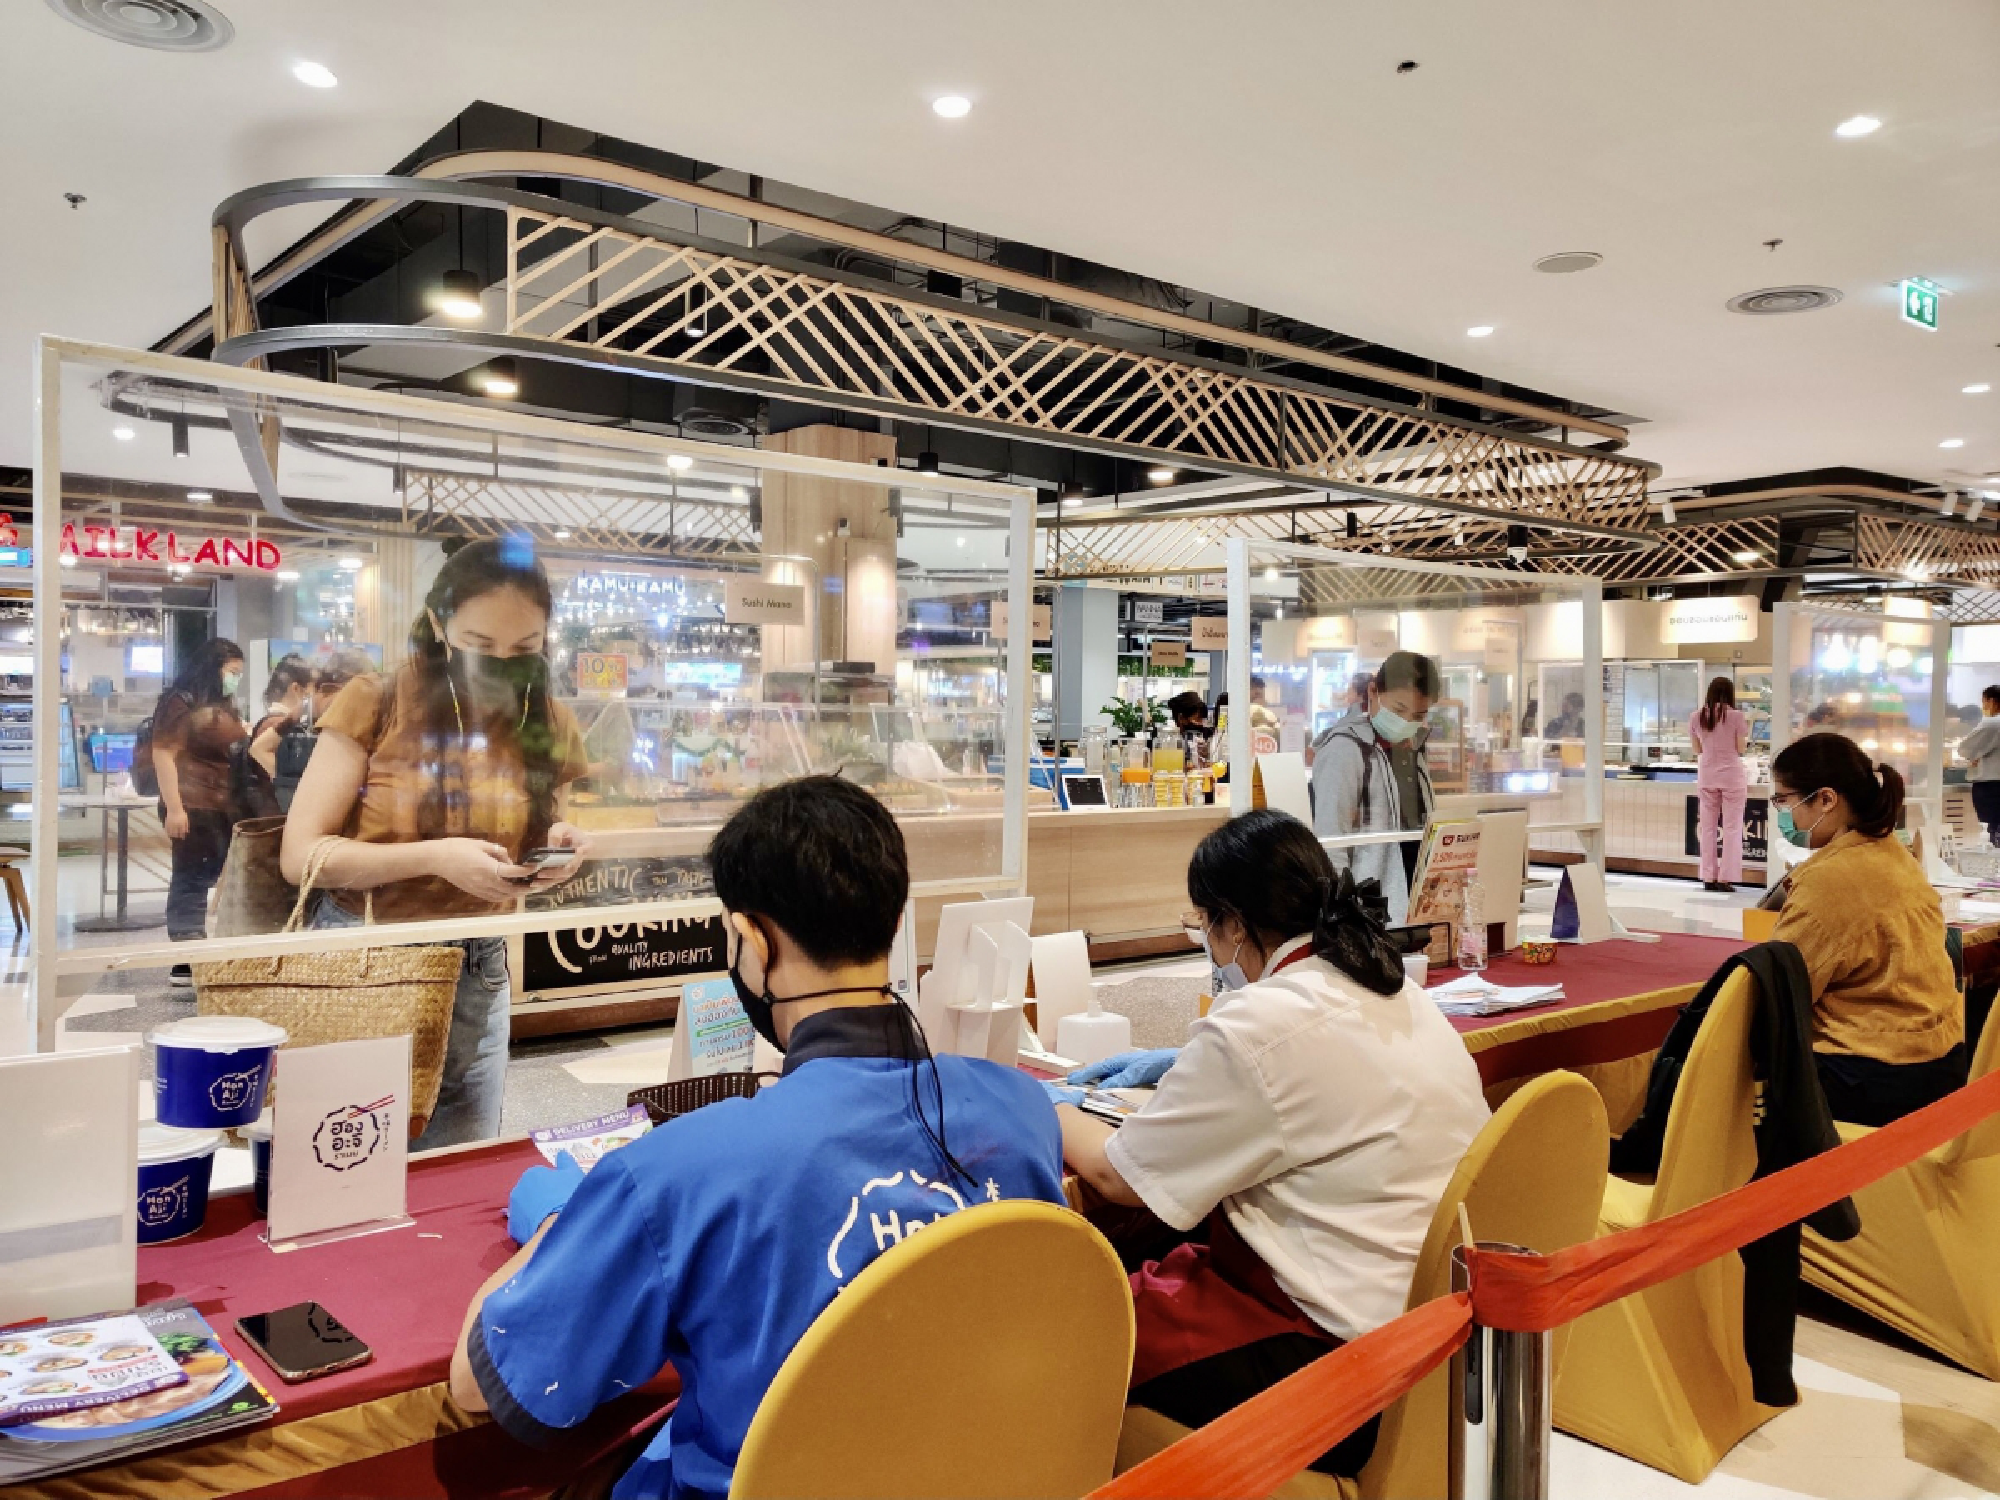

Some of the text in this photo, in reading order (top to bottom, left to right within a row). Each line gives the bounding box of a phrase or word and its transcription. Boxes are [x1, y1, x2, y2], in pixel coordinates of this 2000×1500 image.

[741, 597, 764, 608] Sushi
[611, 941, 649, 955] QUALITY
[627, 946, 713, 970] INGREDIENTS
[552, 1110, 629, 1136] DELIVERY MENU
